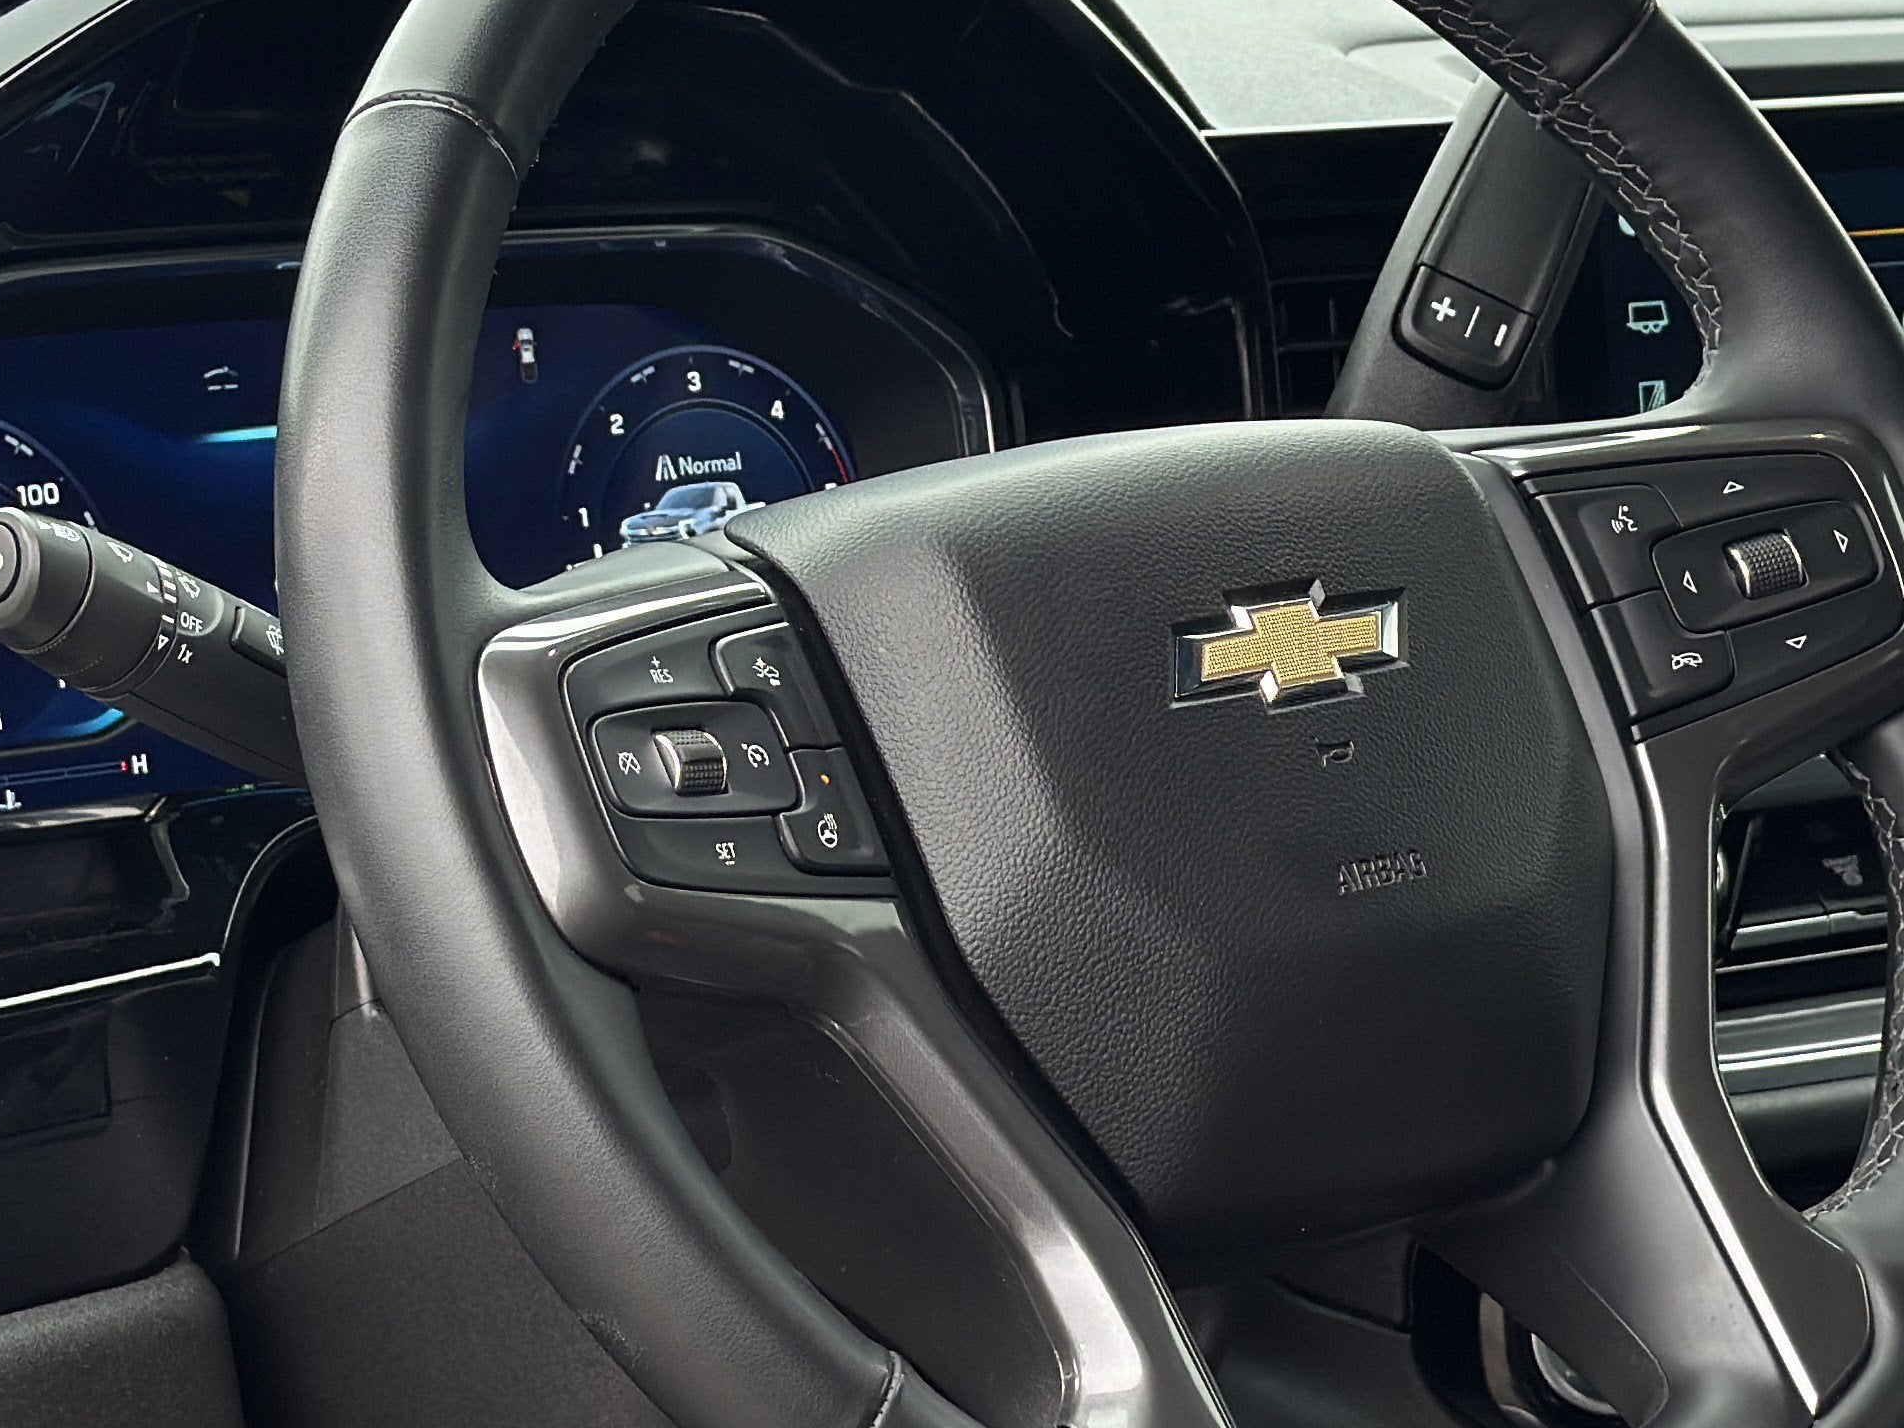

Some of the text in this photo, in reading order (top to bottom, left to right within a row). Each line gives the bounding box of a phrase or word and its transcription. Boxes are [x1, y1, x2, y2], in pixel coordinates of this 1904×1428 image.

[687, 371, 702, 392] 3
[771, 400, 784, 420] 4
[610, 413, 624, 435] 2
[679, 451, 742, 475] Normal
[17, 482, 60, 507] 100
[578, 507, 589, 527] 1
[180, 611, 203, 634] OFF
[650, 669, 674, 684] RES
[130, 754, 148, 775] H
[716, 842, 736, 860] SET
[1338, 851, 1427, 895] AIRBAG
